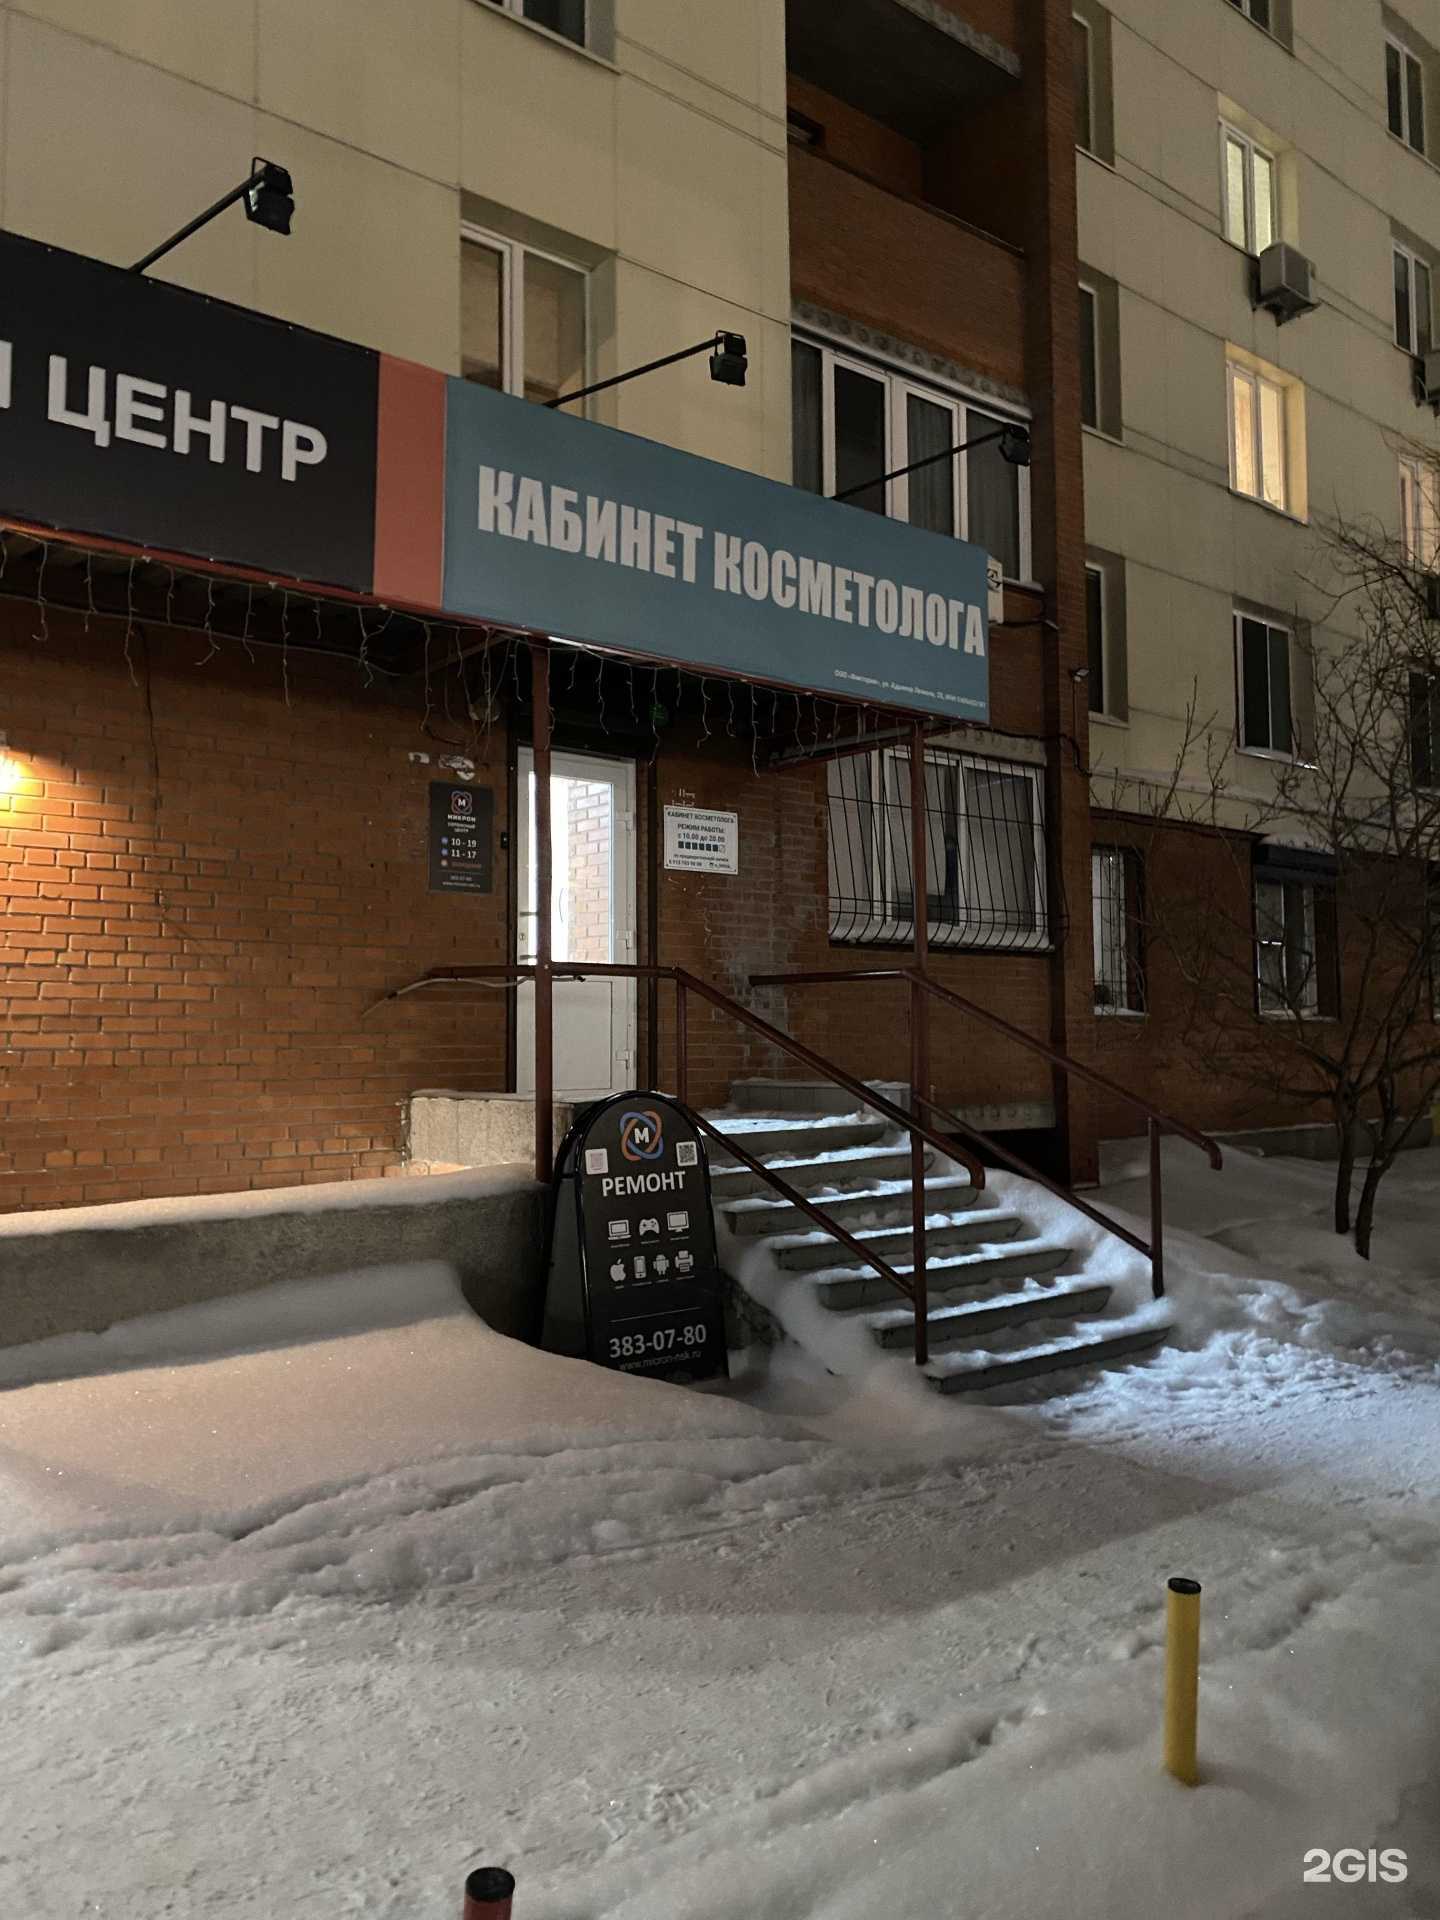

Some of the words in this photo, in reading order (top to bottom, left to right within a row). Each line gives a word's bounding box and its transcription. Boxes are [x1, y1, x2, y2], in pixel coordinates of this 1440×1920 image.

[48, 354, 328, 482] ЦЕНТР
[477, 464, 704, 584] КАБИНЕТ
[713, 531, 985, 657] КОСМЕТОЛОГА
[667, 811, 693, 819] КАБИНЕТ
[451, 838, 461, 846] 10
[467, 840, 477, 848] 19
[451, 849, 461, 857] 11
[467, 851, 477, 859] 17
[634, 1127, 650, 1144] М
[602, 1171, 686, 1197] РЕМОНТ
[609, 1324, 707, 1358] 383-07-80
